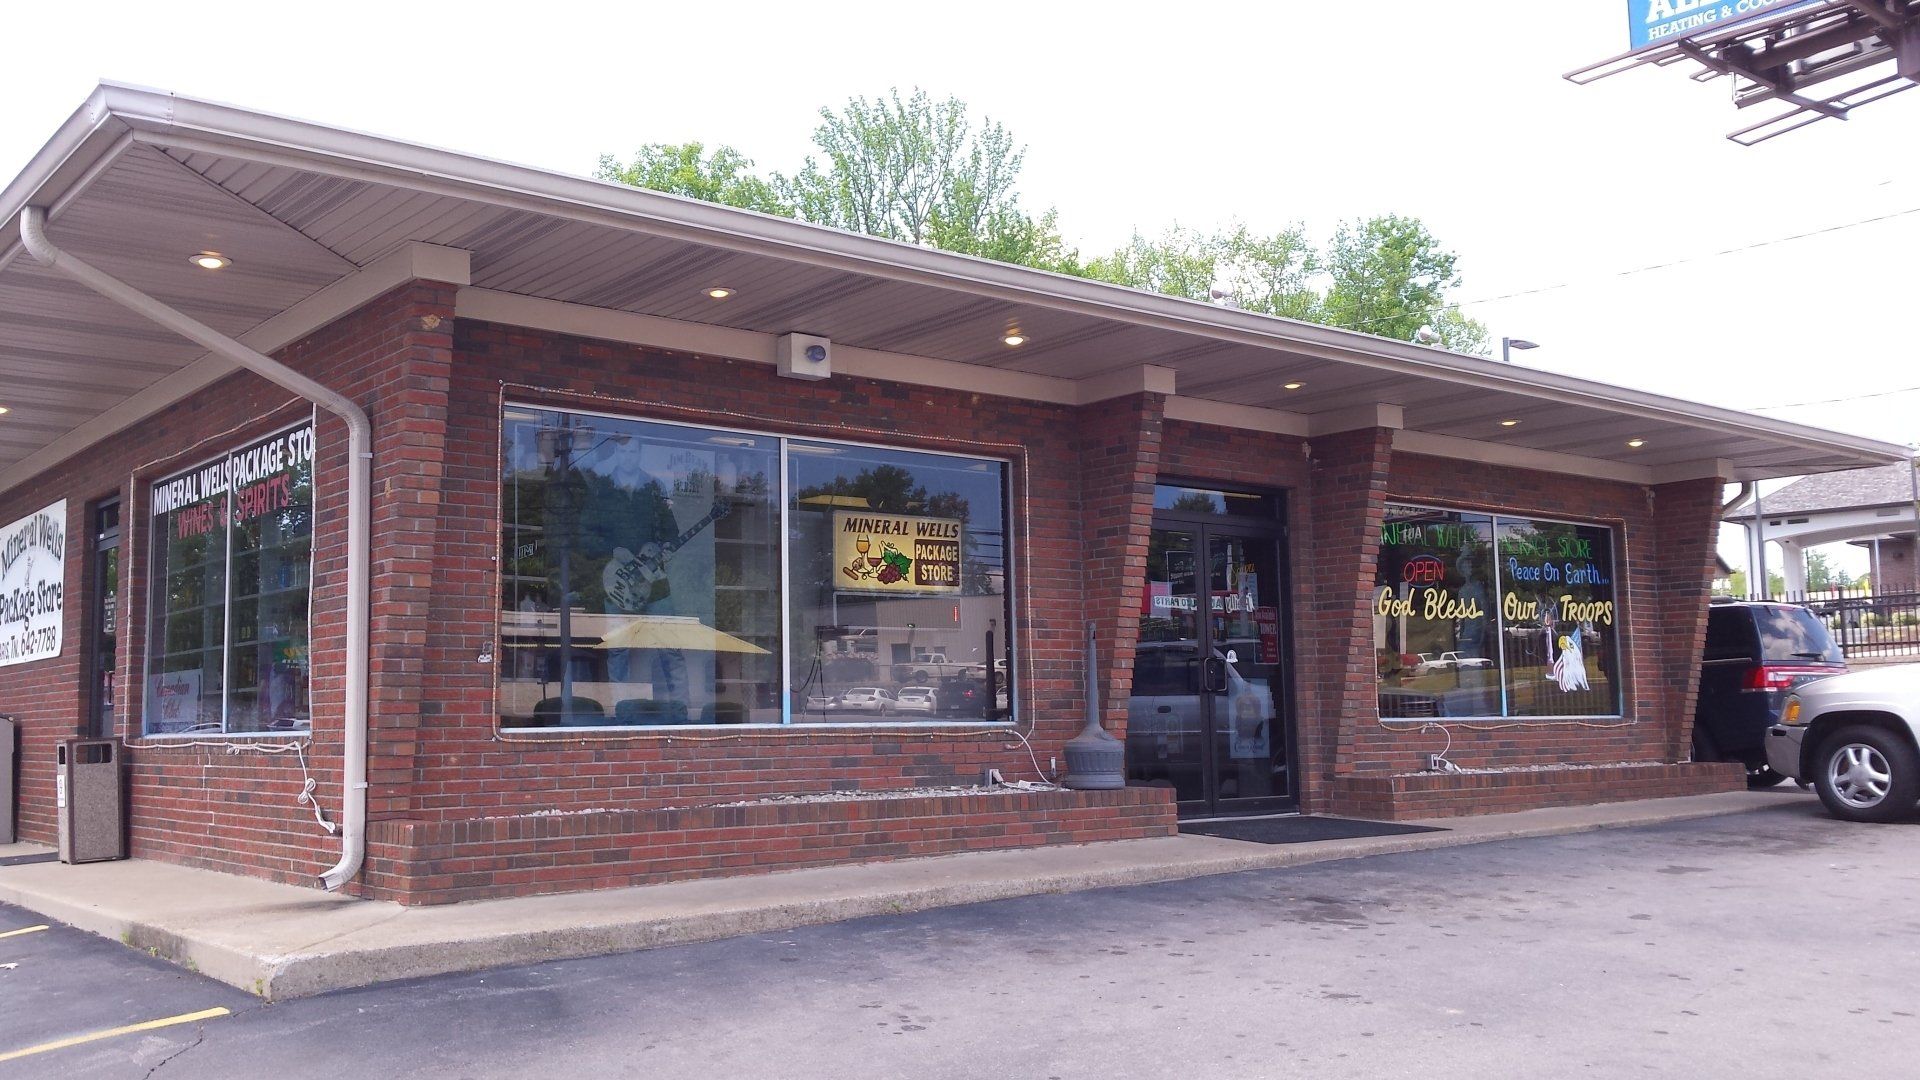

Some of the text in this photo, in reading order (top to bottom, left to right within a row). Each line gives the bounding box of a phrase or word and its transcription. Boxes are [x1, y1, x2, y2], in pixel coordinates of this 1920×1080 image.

[1648, 9, 1717, 41] HEATING
[1720, 5, 1733, 18] &
[153, 474, 199, 516] MINERAL
[200, 458, 230, 499] WELLS
[233, 438, 284, 491] PACKAGE
[178, 502, 214, 540] WINES
[235, 473, 290, 521] SPIRITS
[843, 518, 959, 538] MINERAL WELLS
[1, 514, 63, 582] Mineral Wells
[915, 544, 958, 562] PACKAGE
[921, 564, 954, 582] STORE
[1403, 561, 1444, 582] OPEN
[1509, 557, 1540, 581] Peace
[1543, 562, 1560, 582] On
[37, 579, 62, 616] Store
[1378, 586, 1416, 617] God
[1424, 588, 1484, 621] Bless
[1504, 591, 1539, 620] Our
[21, 625, 56, 657] 642-7788
